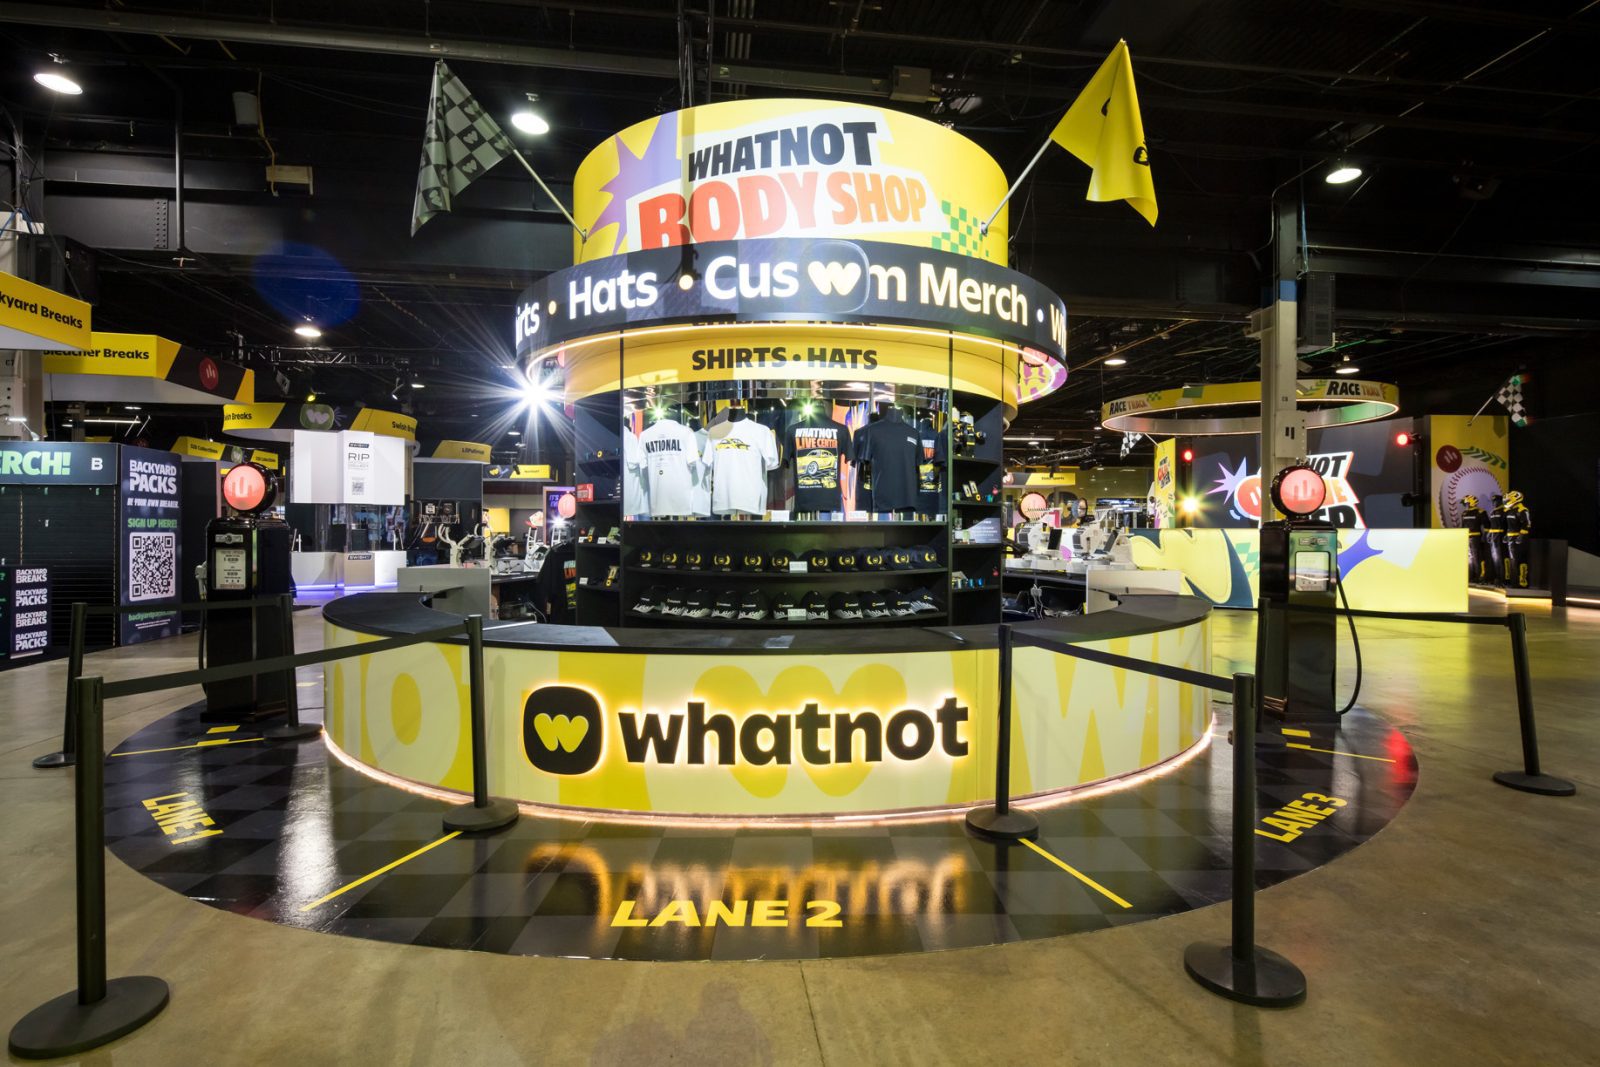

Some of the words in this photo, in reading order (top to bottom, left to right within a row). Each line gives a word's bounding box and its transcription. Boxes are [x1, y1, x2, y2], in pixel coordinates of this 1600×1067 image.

[688, 121, 877, 182] WHATNOT
[638, 171, 818, 249] BODY
[827, 171, 927, 225] SHOP
[568, 269, 659, 320] Hats
[920, 262, 1028, 326] Merch
[41, 306, 83, 329] Breaks
[103, 348, 150, 360] Breaks
[692, 347, 788, 371] SHIRTS
[807, 347, 878, 371] HATS
[1326, 381, 1361, 396] RACE
[1109, 400, 1127, 415] RACE
[795, 427, 838, 440] WHATNOT
[645, 438, 682, 454] NATIONAL
[796, 437, 816, 449] LIVE
[0, 450, 71, 476] RCH!
[91, 457, 103, 471] B
[348, 452, 370, 461] RIP
[129, 459, 177, 476] BACKYARD
[129, 472, 177, 494] PACKS
[127, 517, 146, 528] SIGN
[147, 518, 157, 528] UP
[16, 594, 47, 607] PACKS
[16, 637, 47, 651] PACKS
[618, 697, 969, 766] whatnot
[142, 792, 216, 836] LANE
[1254, 800, 1337, 843] LANE
[1302, 792, 1348, 807] 3
[171, 829, 224, 845] 1
[610, 900, 789, 927] LANE
[806, 900, 843, 927] 2
